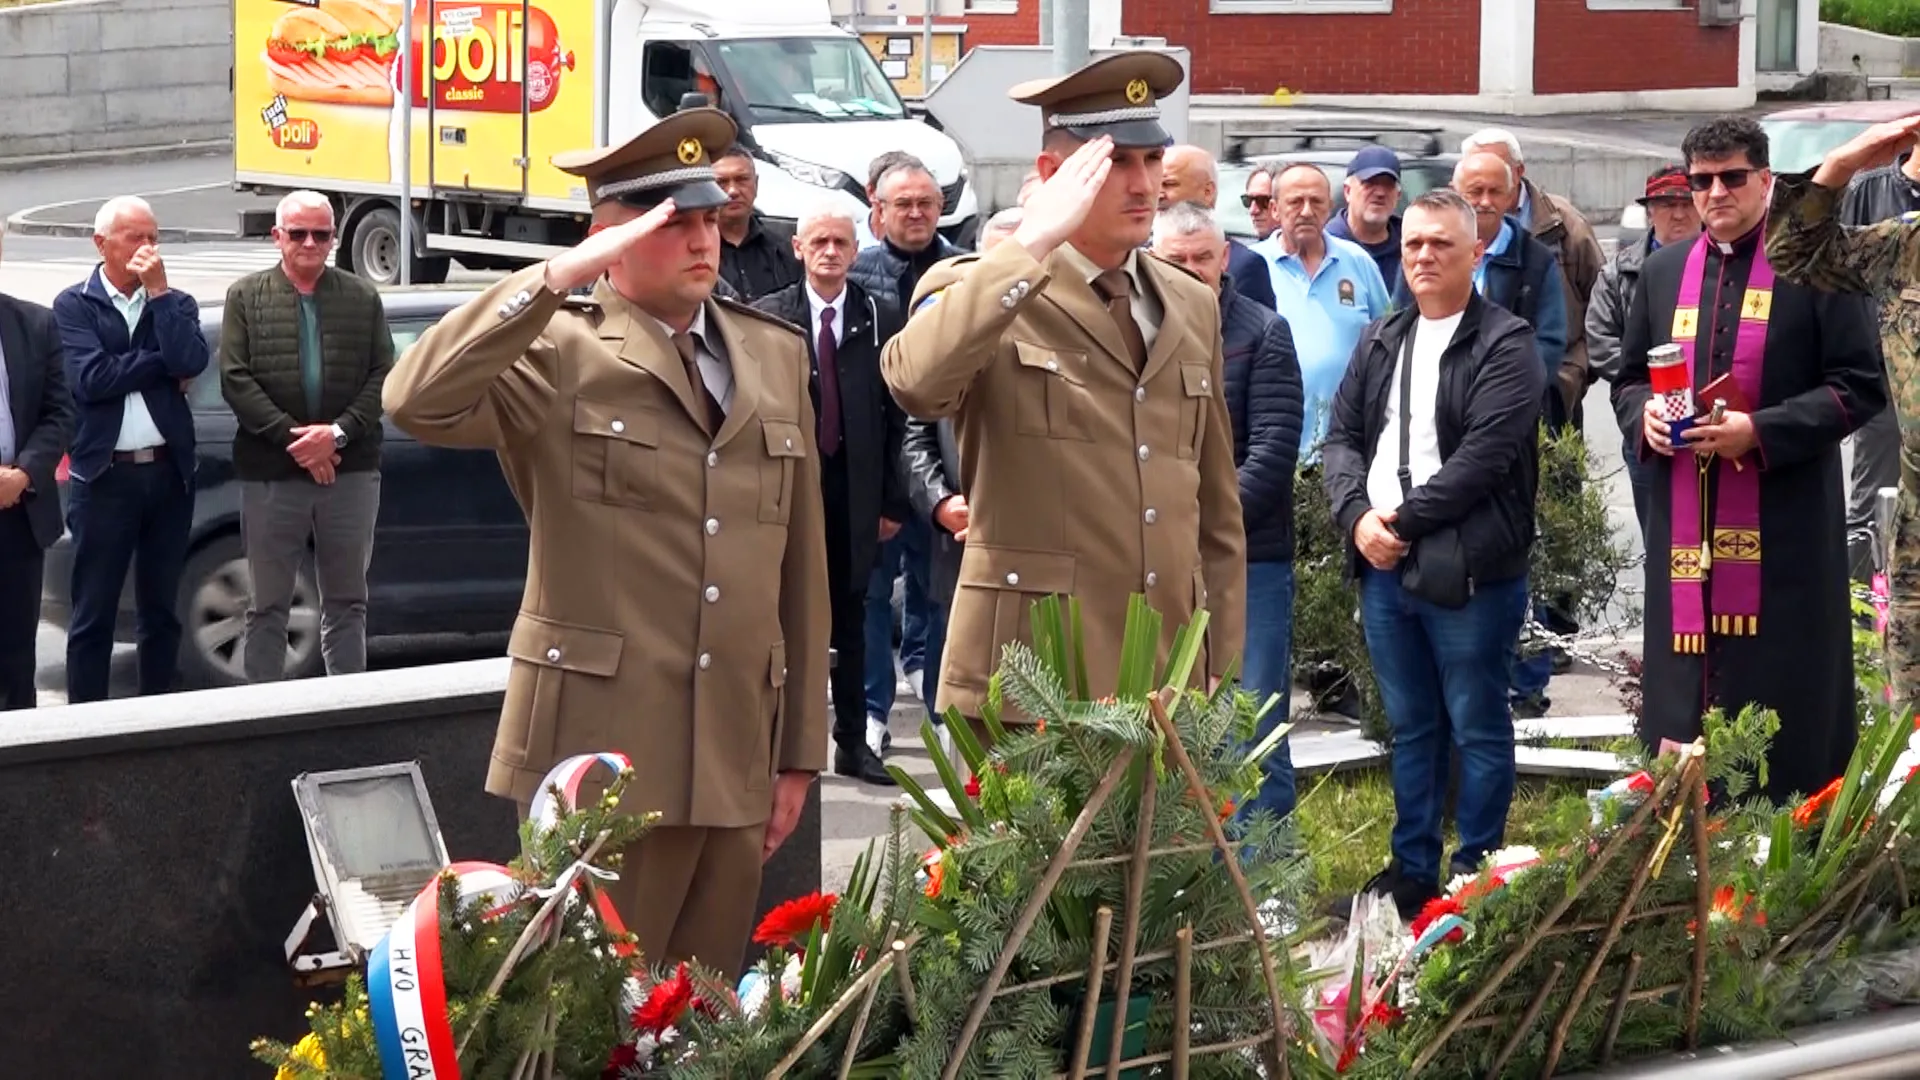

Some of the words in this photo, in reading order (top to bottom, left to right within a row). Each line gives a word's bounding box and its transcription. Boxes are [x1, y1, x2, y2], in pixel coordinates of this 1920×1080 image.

[422, 8, 523, 99] poli
[445, 85, 484, 102] classic
[280, 120, 311, 148] poli
[392, 948, 416, 992] HVO
[400, 1026, 432, 1080] GRA
